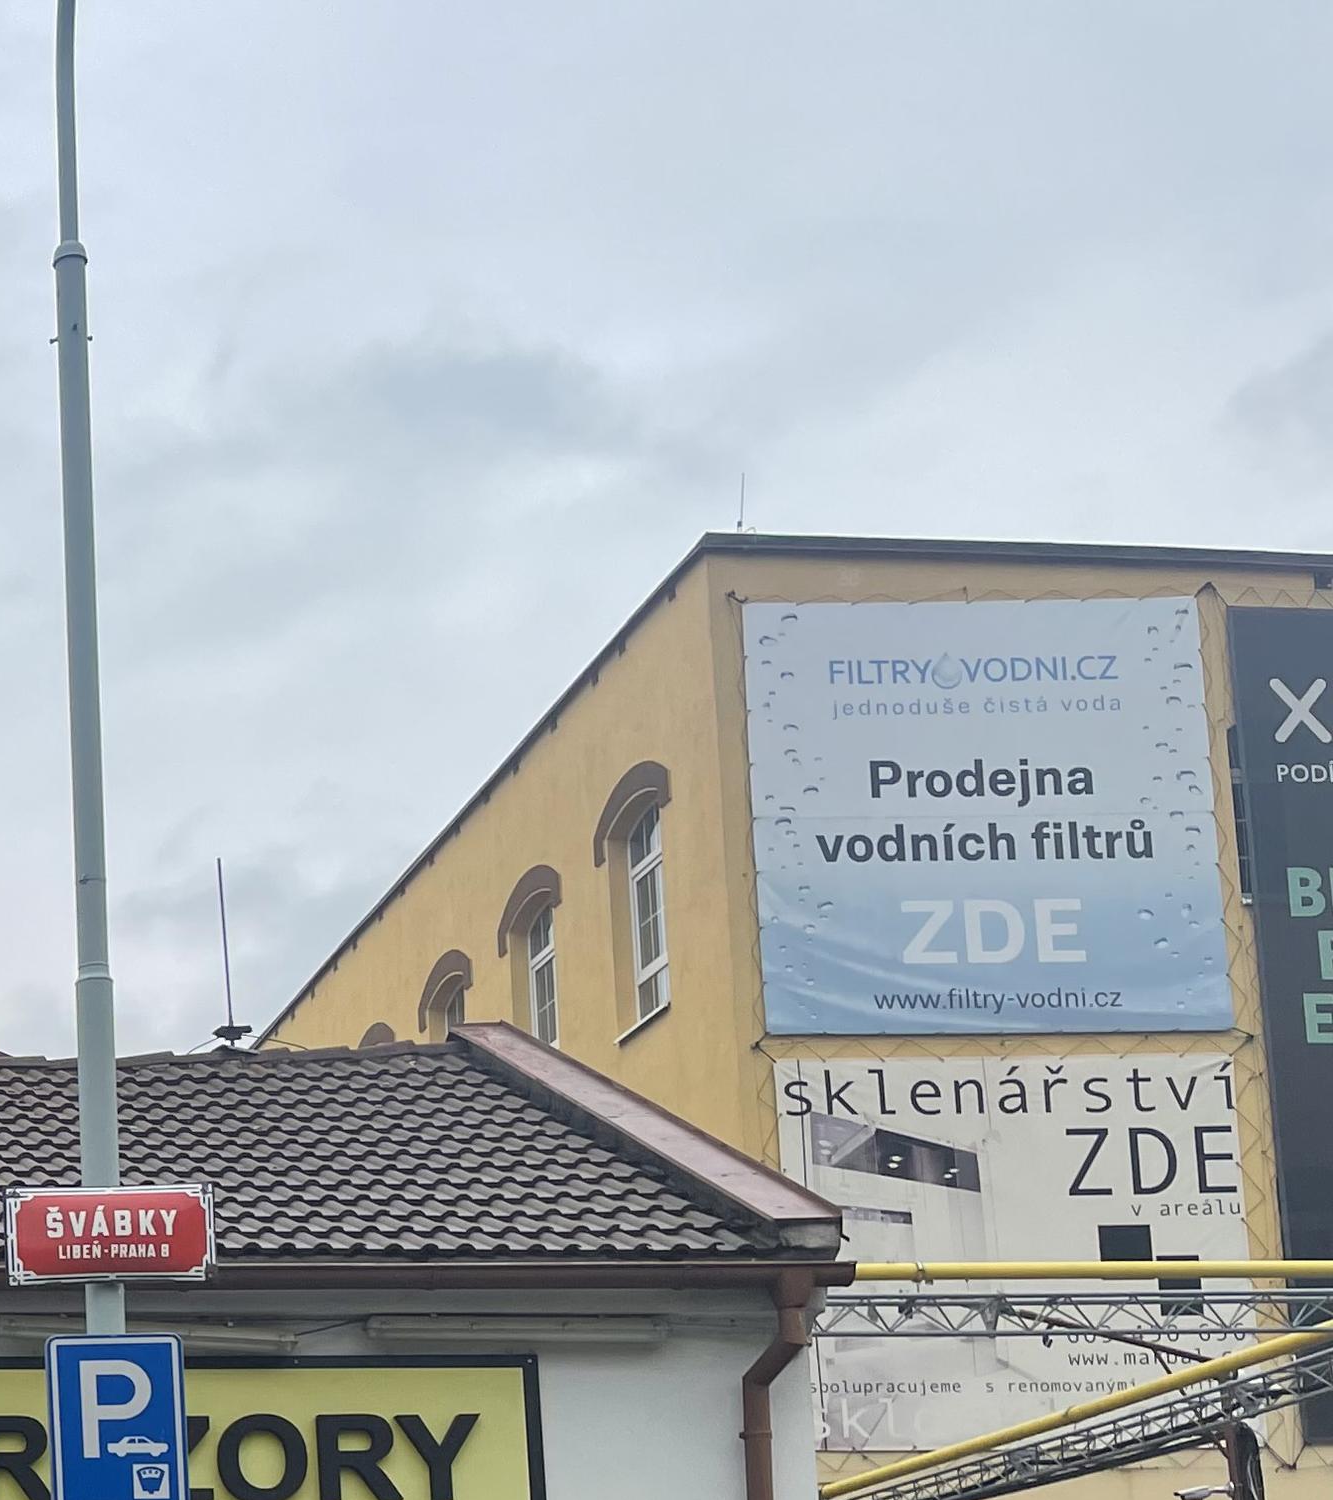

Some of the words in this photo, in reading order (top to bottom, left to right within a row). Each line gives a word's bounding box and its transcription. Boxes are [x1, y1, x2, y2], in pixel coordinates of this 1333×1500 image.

[832, 697, 971, 719] jednoduše
[984, 695, 1049, 714] čistá
[1061, 695, 1122, 713] voda
[869, 759, 1094, 807] Prodejna
[1277, 759, 1333, 783] POD
[815, 822, 1017, 863] vodních
[1030, 819, 1155, 861] filtrů
[1287, 866, 1333, 918] B
[899, 897, 1087, 965] ZDE
[873, 988, 1123, 1014] www.filtry-vodni.cz
[783, 1062, 1235, 1116] sklenářství
[1065, 1125, 1238, 1197] ZDE
[45, 1205, 177, 1239] ŠVÁBKY
[1131, 1204, 1142, 1216] v
[1159, 1198, 1242, 1217] areálu
[160, 1243, 170, 1258] 8
[810, 1379, 962, 1396] spolupracujeme
[985, 1381, 994, 1393] s
[79, 1359, 153, 1459] P
